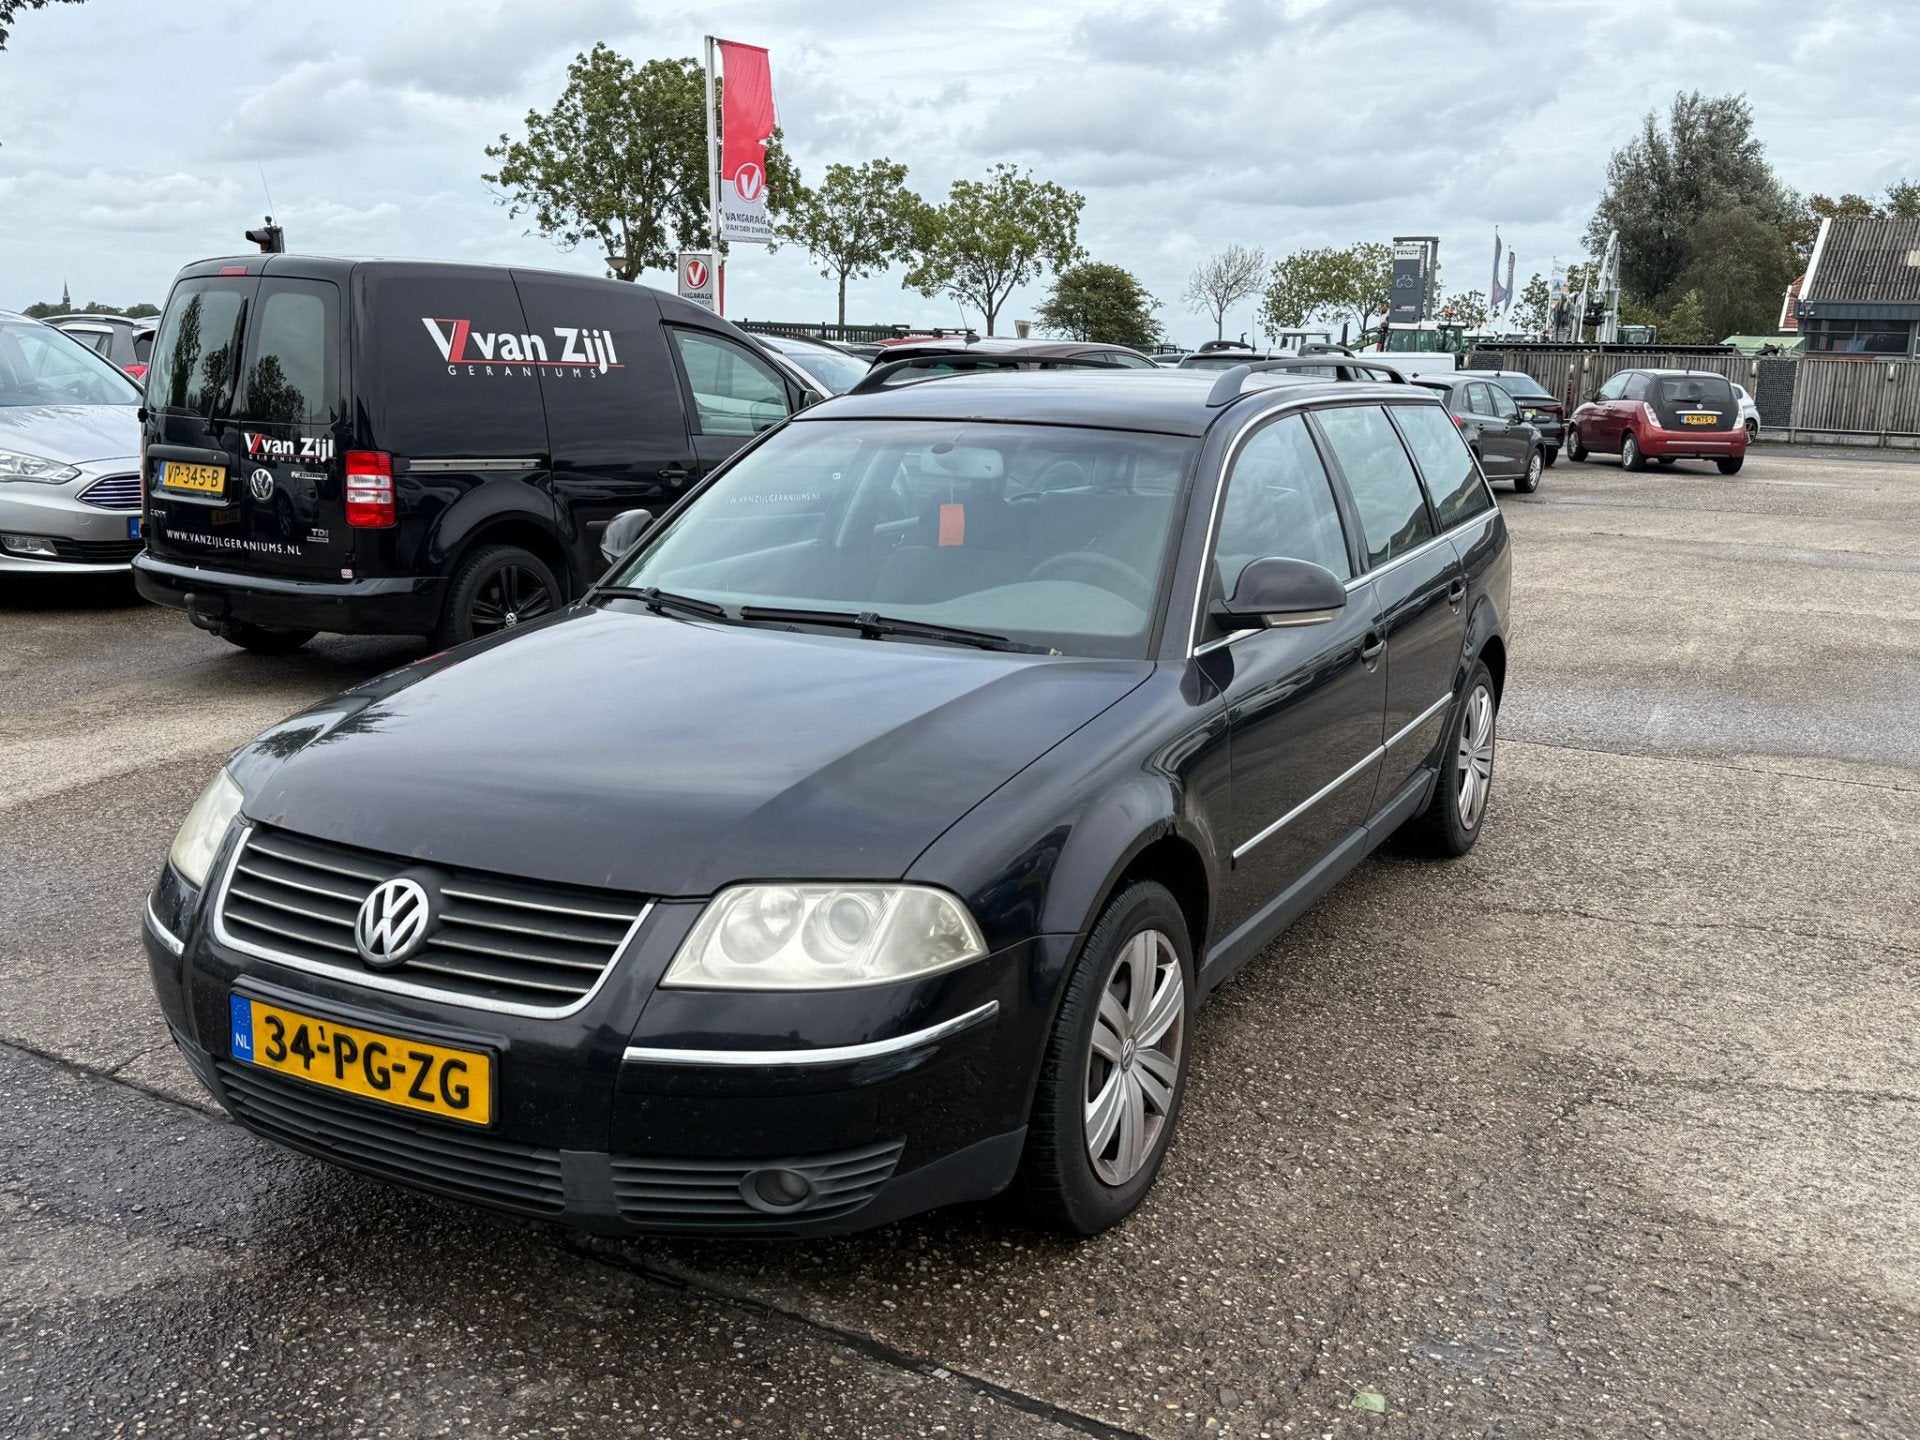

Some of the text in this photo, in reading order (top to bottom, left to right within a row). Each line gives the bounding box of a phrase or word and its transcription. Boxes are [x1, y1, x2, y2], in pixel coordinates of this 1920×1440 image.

[471, 332, 548, 361] van
[553, 327, 618, 375] Zijl
[447, 365, 596, 379] GERANIUMS
[248, 454, 319, 464] GERANIUMS
[261, 439, 294, 455] van
[300, 437, 334, 462] Zijl
[167, 465, 219, 488] VP-345-B
[166, 529, 302, 556] WWW.VANZIJLGERANIUMS.NL
[235, 1034, 250, 1050] NL
[264, 1014, 470, 1110] 34-PG-ZG
